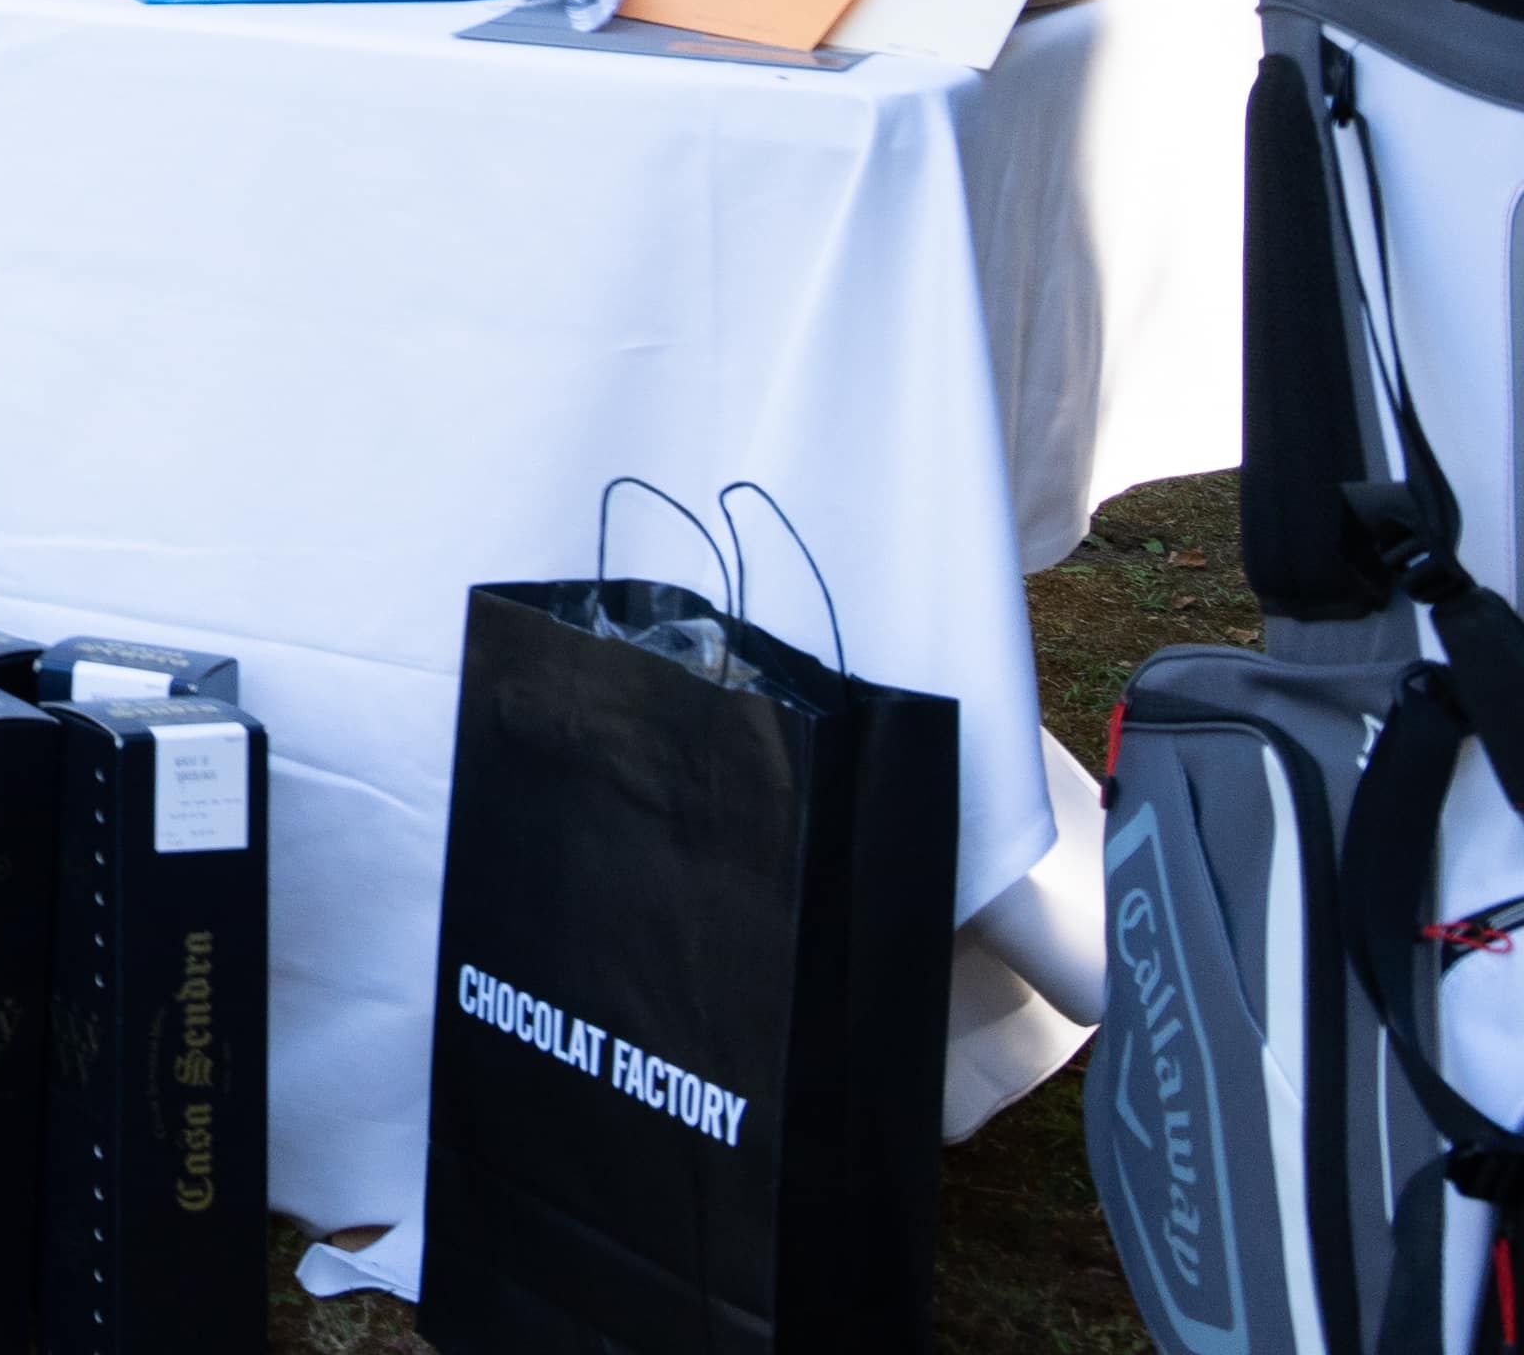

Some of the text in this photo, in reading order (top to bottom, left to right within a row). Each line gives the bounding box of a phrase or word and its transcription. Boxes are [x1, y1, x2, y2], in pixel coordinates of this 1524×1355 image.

[174, 930, 214, 1212] Casa Sendra
[458, 963, 747, 1148] CHOCOLAT FACTORY
[1115, 886, 1202, 1289] Callaway
